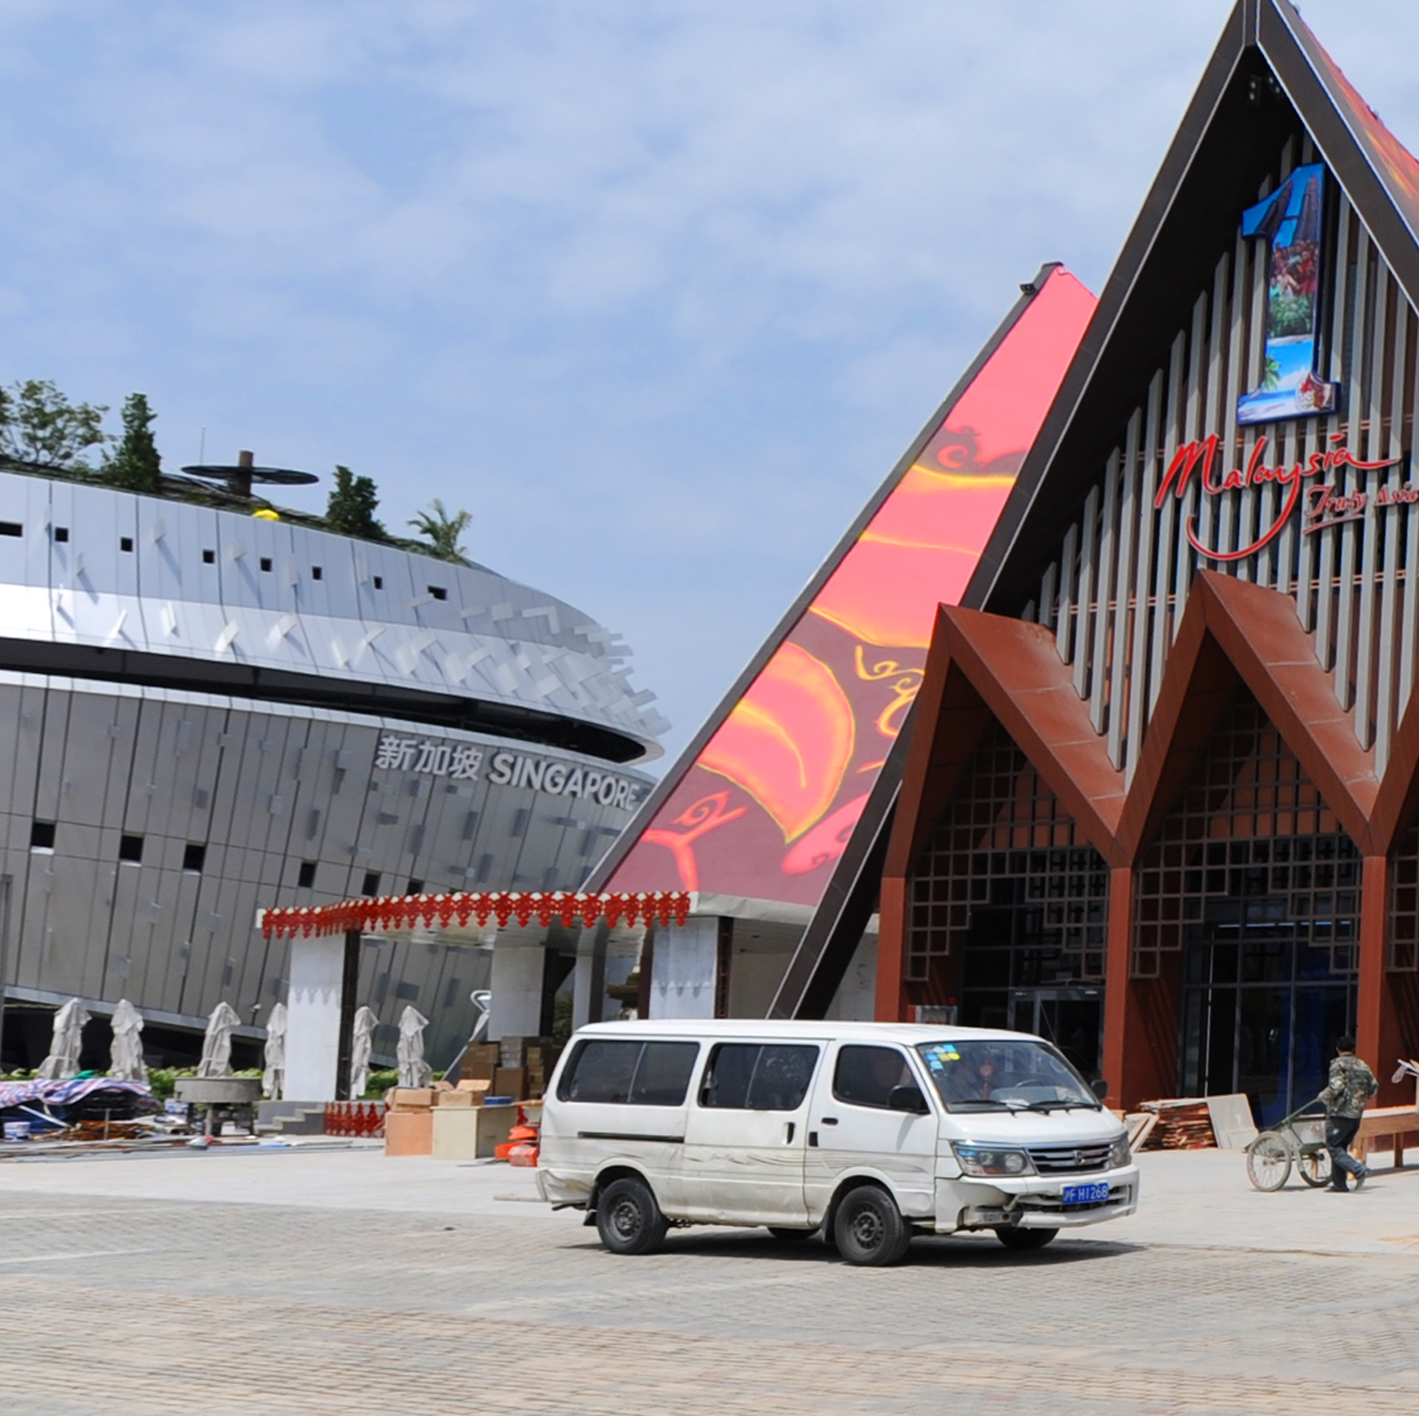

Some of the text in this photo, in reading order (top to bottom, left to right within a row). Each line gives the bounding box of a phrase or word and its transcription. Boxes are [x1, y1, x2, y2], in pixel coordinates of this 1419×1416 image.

[1154, 433, 1402, 561] Malaysia
[1304, 484, 1368, 521] Truly
[374, 734, 641, 812] 新加坡 SINGAPORE
